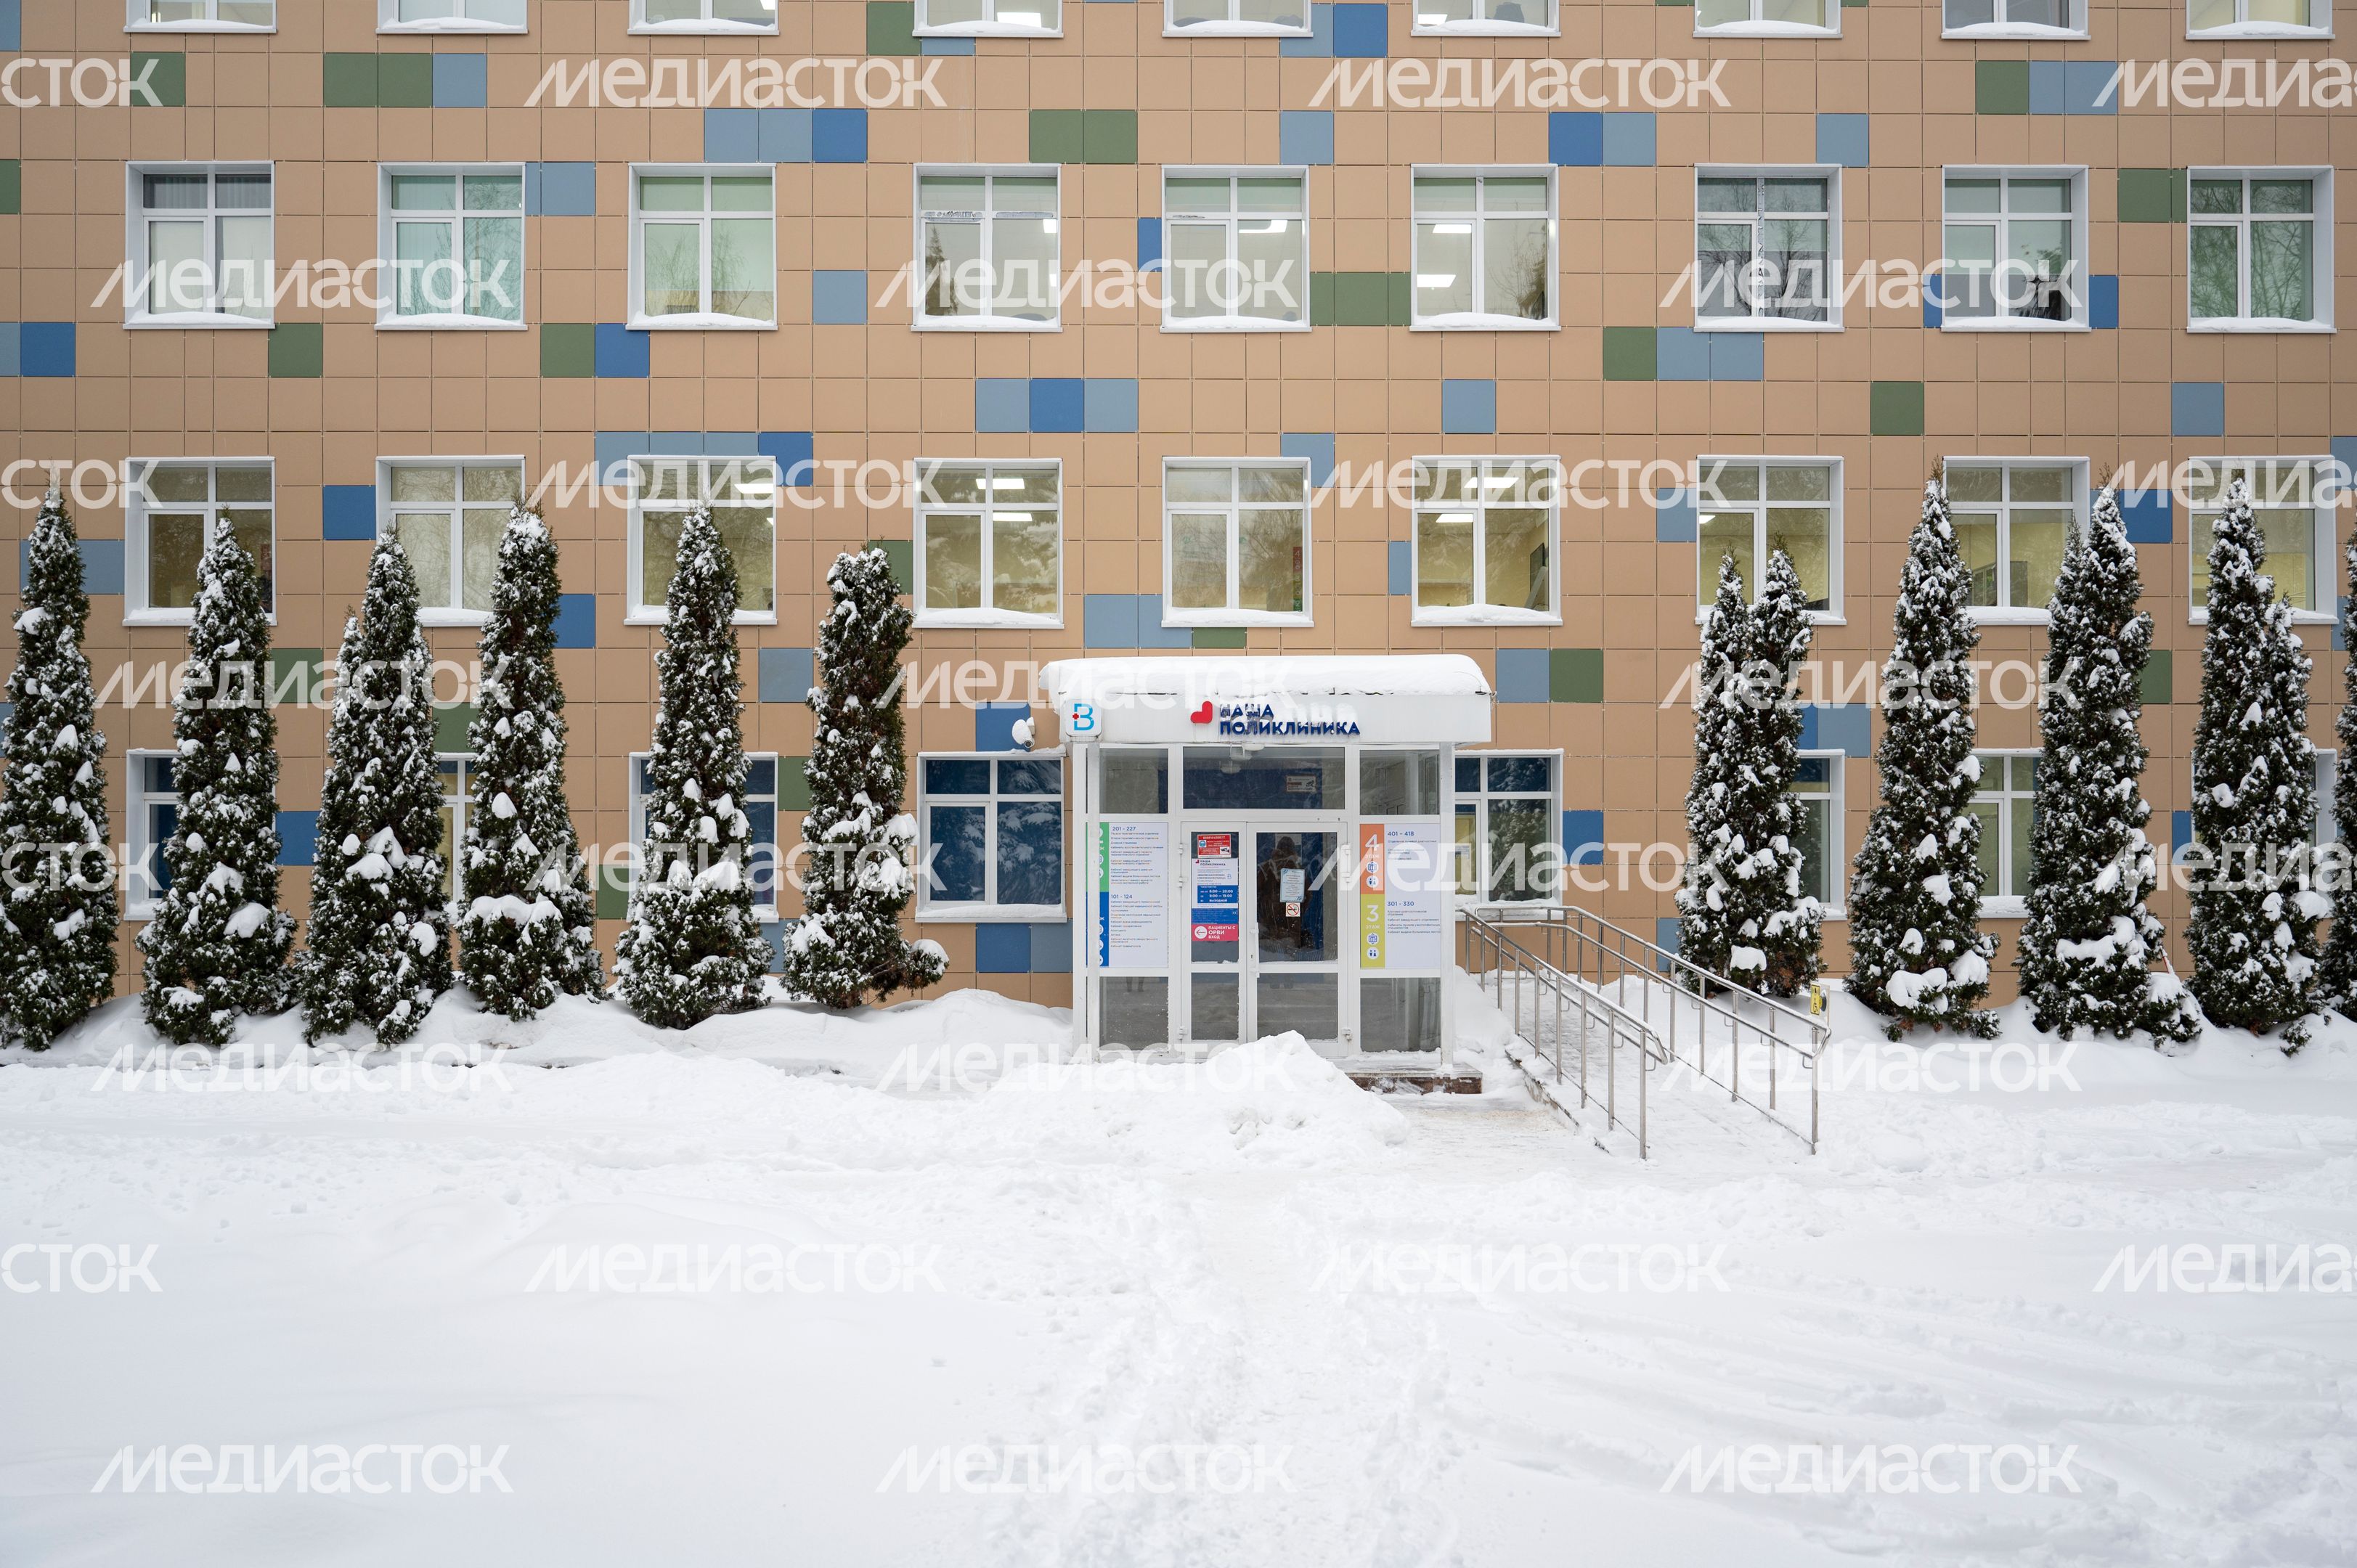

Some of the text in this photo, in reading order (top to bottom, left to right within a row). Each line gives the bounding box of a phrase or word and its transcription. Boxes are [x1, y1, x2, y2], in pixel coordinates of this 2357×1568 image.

[1220, 703, 1274, 717] НАША
[1220, 722, 1361, 735] ПОЛИКЛИНИКА
[1365, 834, 1377, 851] 4
[1367, 905, 1379, 922] 3
